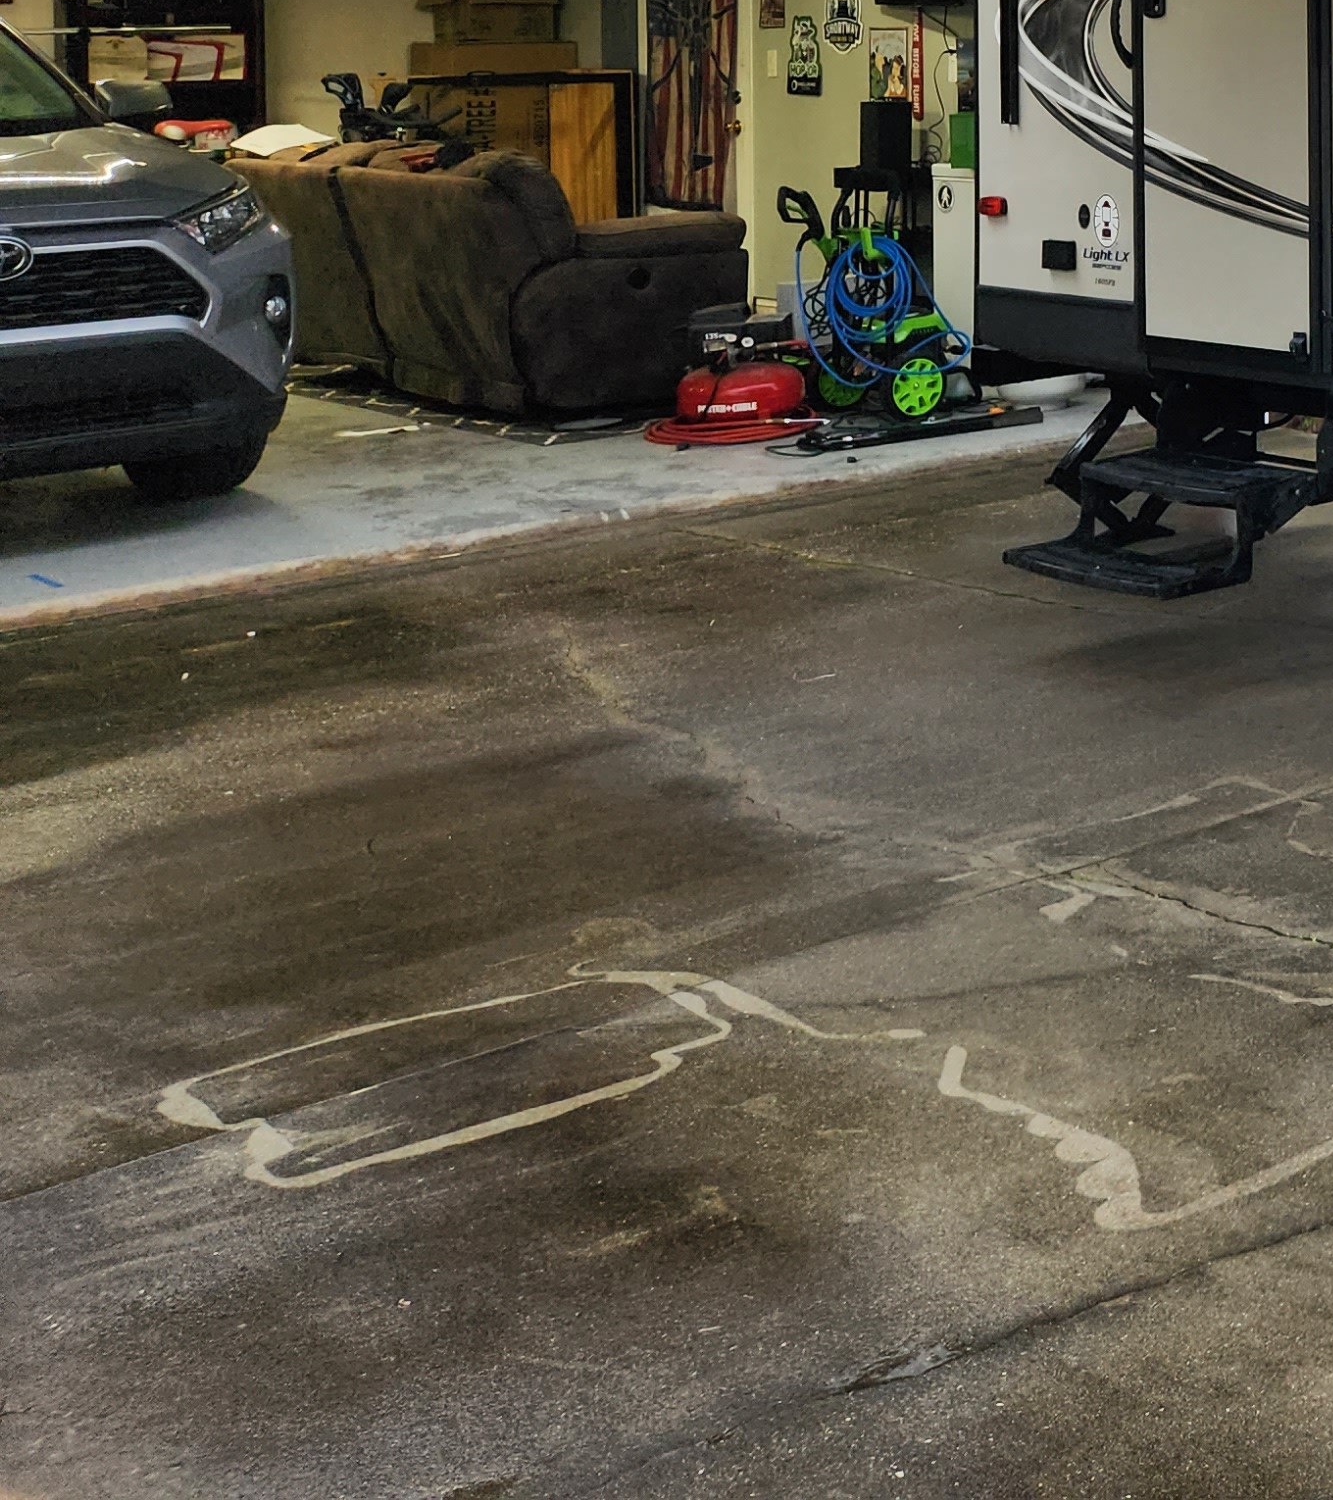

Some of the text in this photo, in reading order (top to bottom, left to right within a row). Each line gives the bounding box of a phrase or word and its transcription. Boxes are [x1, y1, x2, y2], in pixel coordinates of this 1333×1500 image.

[912, 47, 920, 79] BEFORE
[912, 84, 921, 113] FLIGHT
[1083, 246, 1130, 262] Light LX
